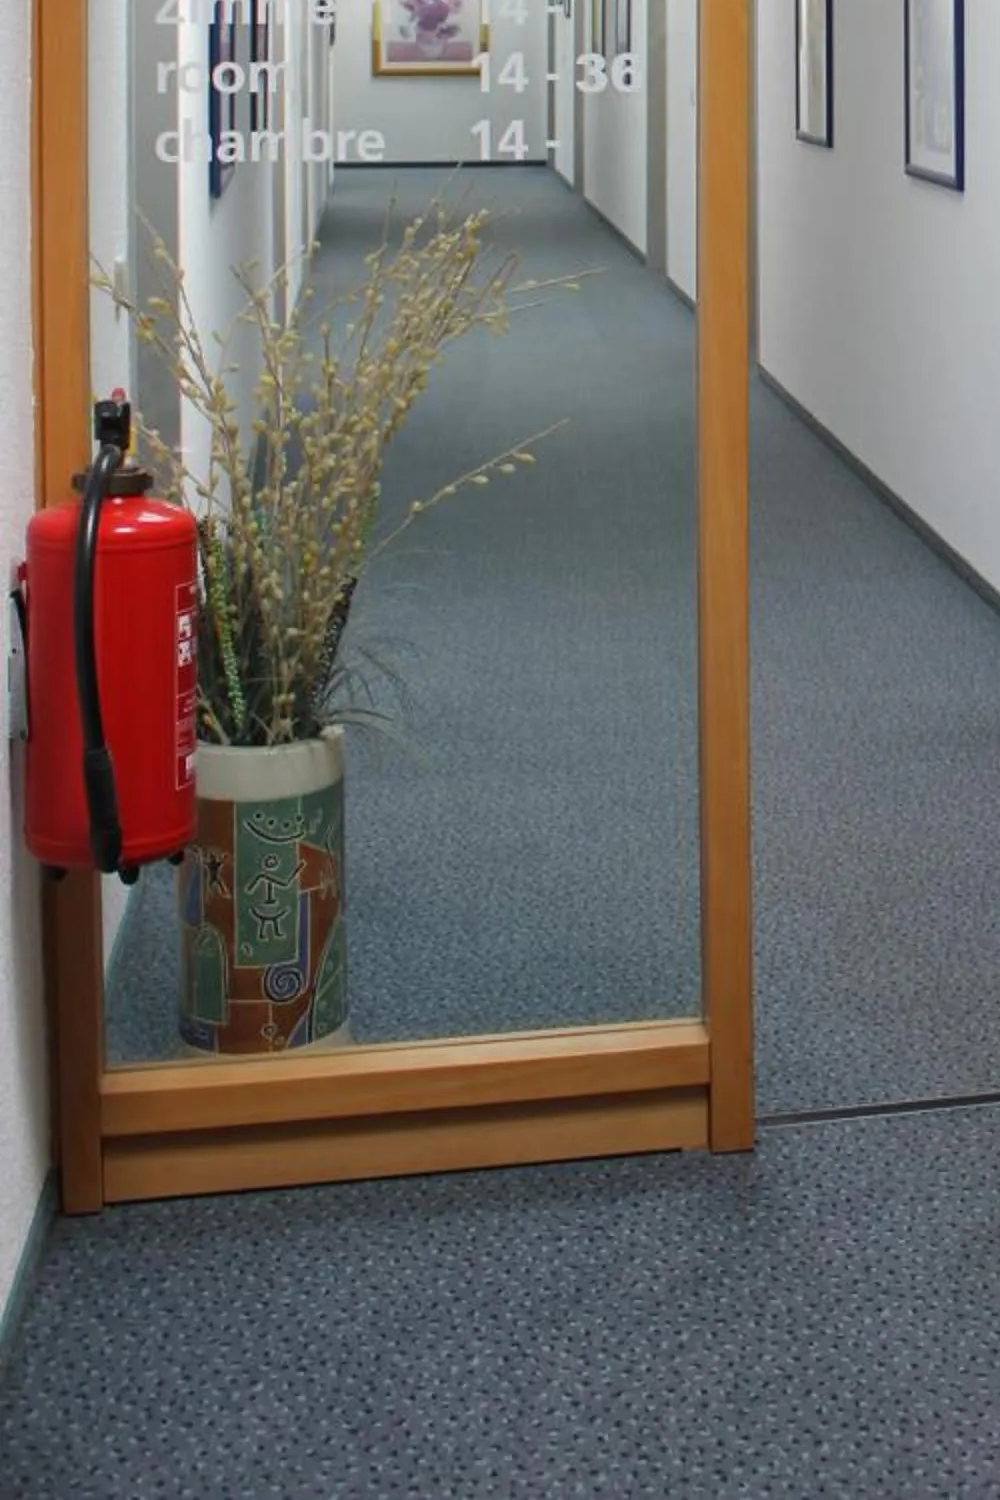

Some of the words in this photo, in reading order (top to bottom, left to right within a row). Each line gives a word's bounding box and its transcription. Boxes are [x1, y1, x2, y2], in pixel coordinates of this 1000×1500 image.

[156, 59, 297, 94] room
[471, 51, 530, 94] 14
[575, 52, 643, 94] 36
[154, 116, 386, 164] chambre
[470, 118, 530, 162] 14
